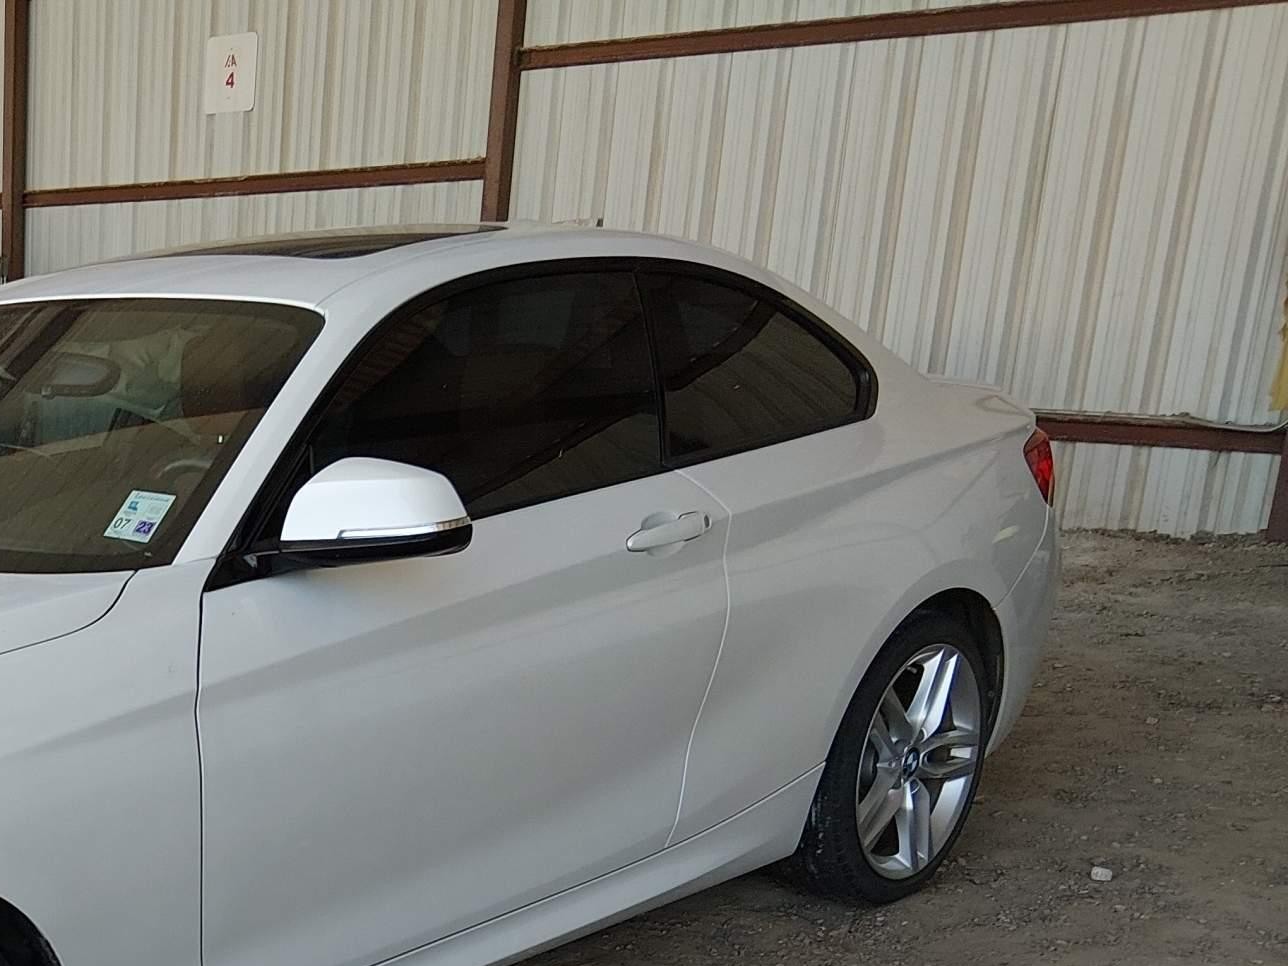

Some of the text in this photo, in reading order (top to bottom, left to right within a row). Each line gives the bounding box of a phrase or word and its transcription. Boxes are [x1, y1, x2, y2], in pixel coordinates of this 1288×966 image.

[225, 72, 235, 88] 4
[113, 518, 154, 534] 07 23
